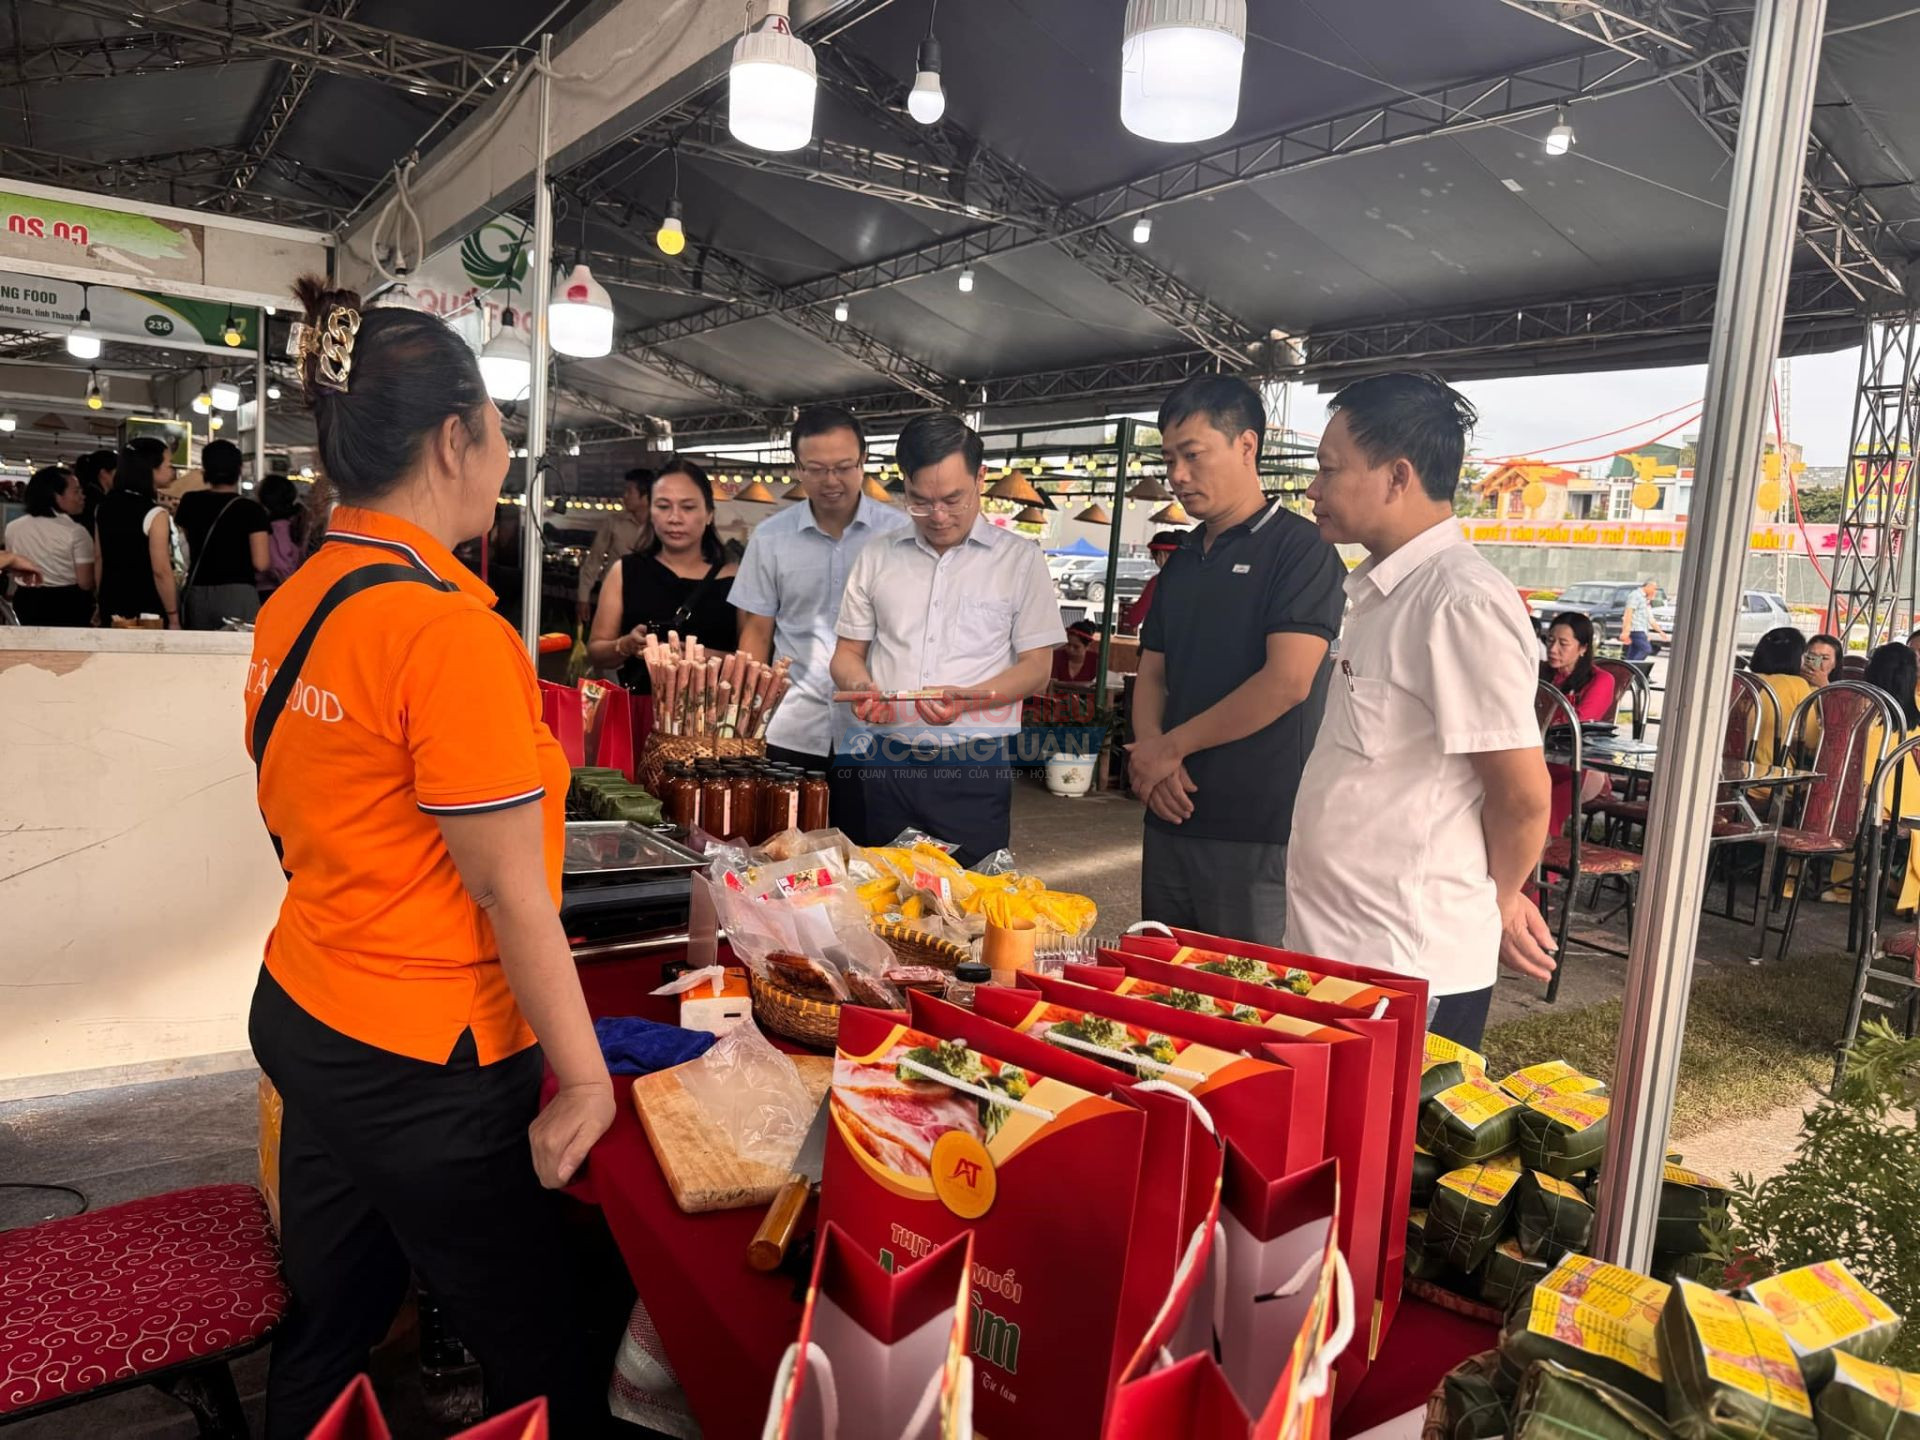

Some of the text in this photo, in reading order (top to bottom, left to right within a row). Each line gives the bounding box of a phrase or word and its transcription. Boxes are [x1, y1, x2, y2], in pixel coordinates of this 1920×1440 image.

[23, 288, 58, 305] FOOD
[148, 319, 171, 331] 236
[890, 1222, 932, 1258] THỊT
